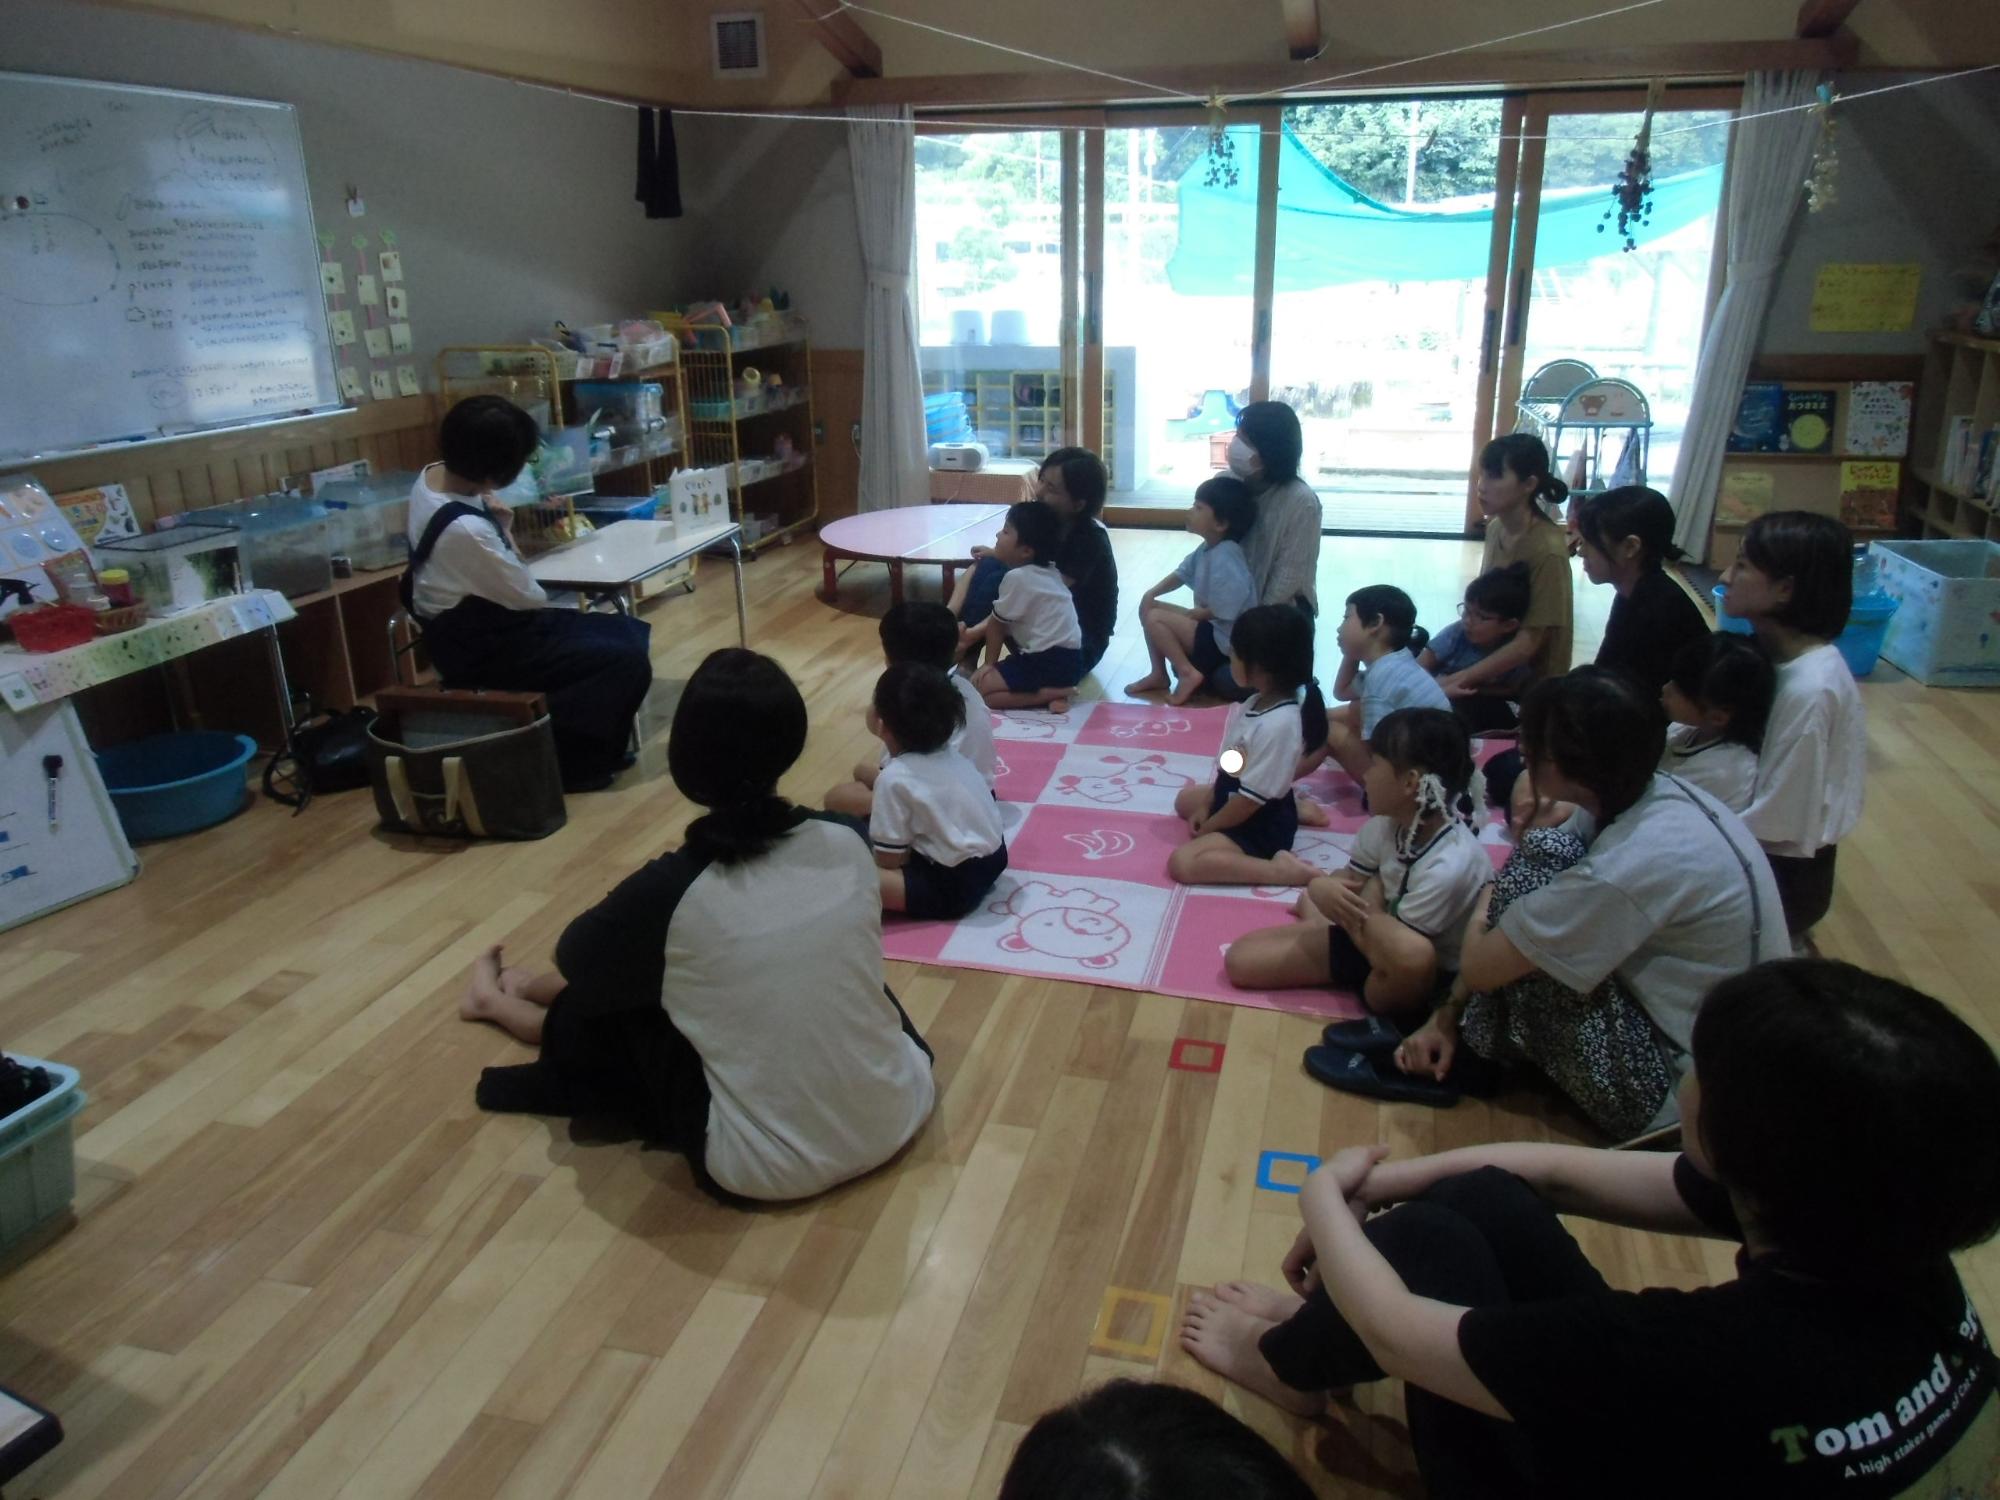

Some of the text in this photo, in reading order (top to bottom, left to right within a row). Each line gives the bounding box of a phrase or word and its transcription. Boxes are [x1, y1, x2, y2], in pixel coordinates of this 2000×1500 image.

[1770, 1352, 1951, 1464] Tom and
[1844, 1465, 1857, 1478] A
[1859, 1454, 1892, 1474] high
